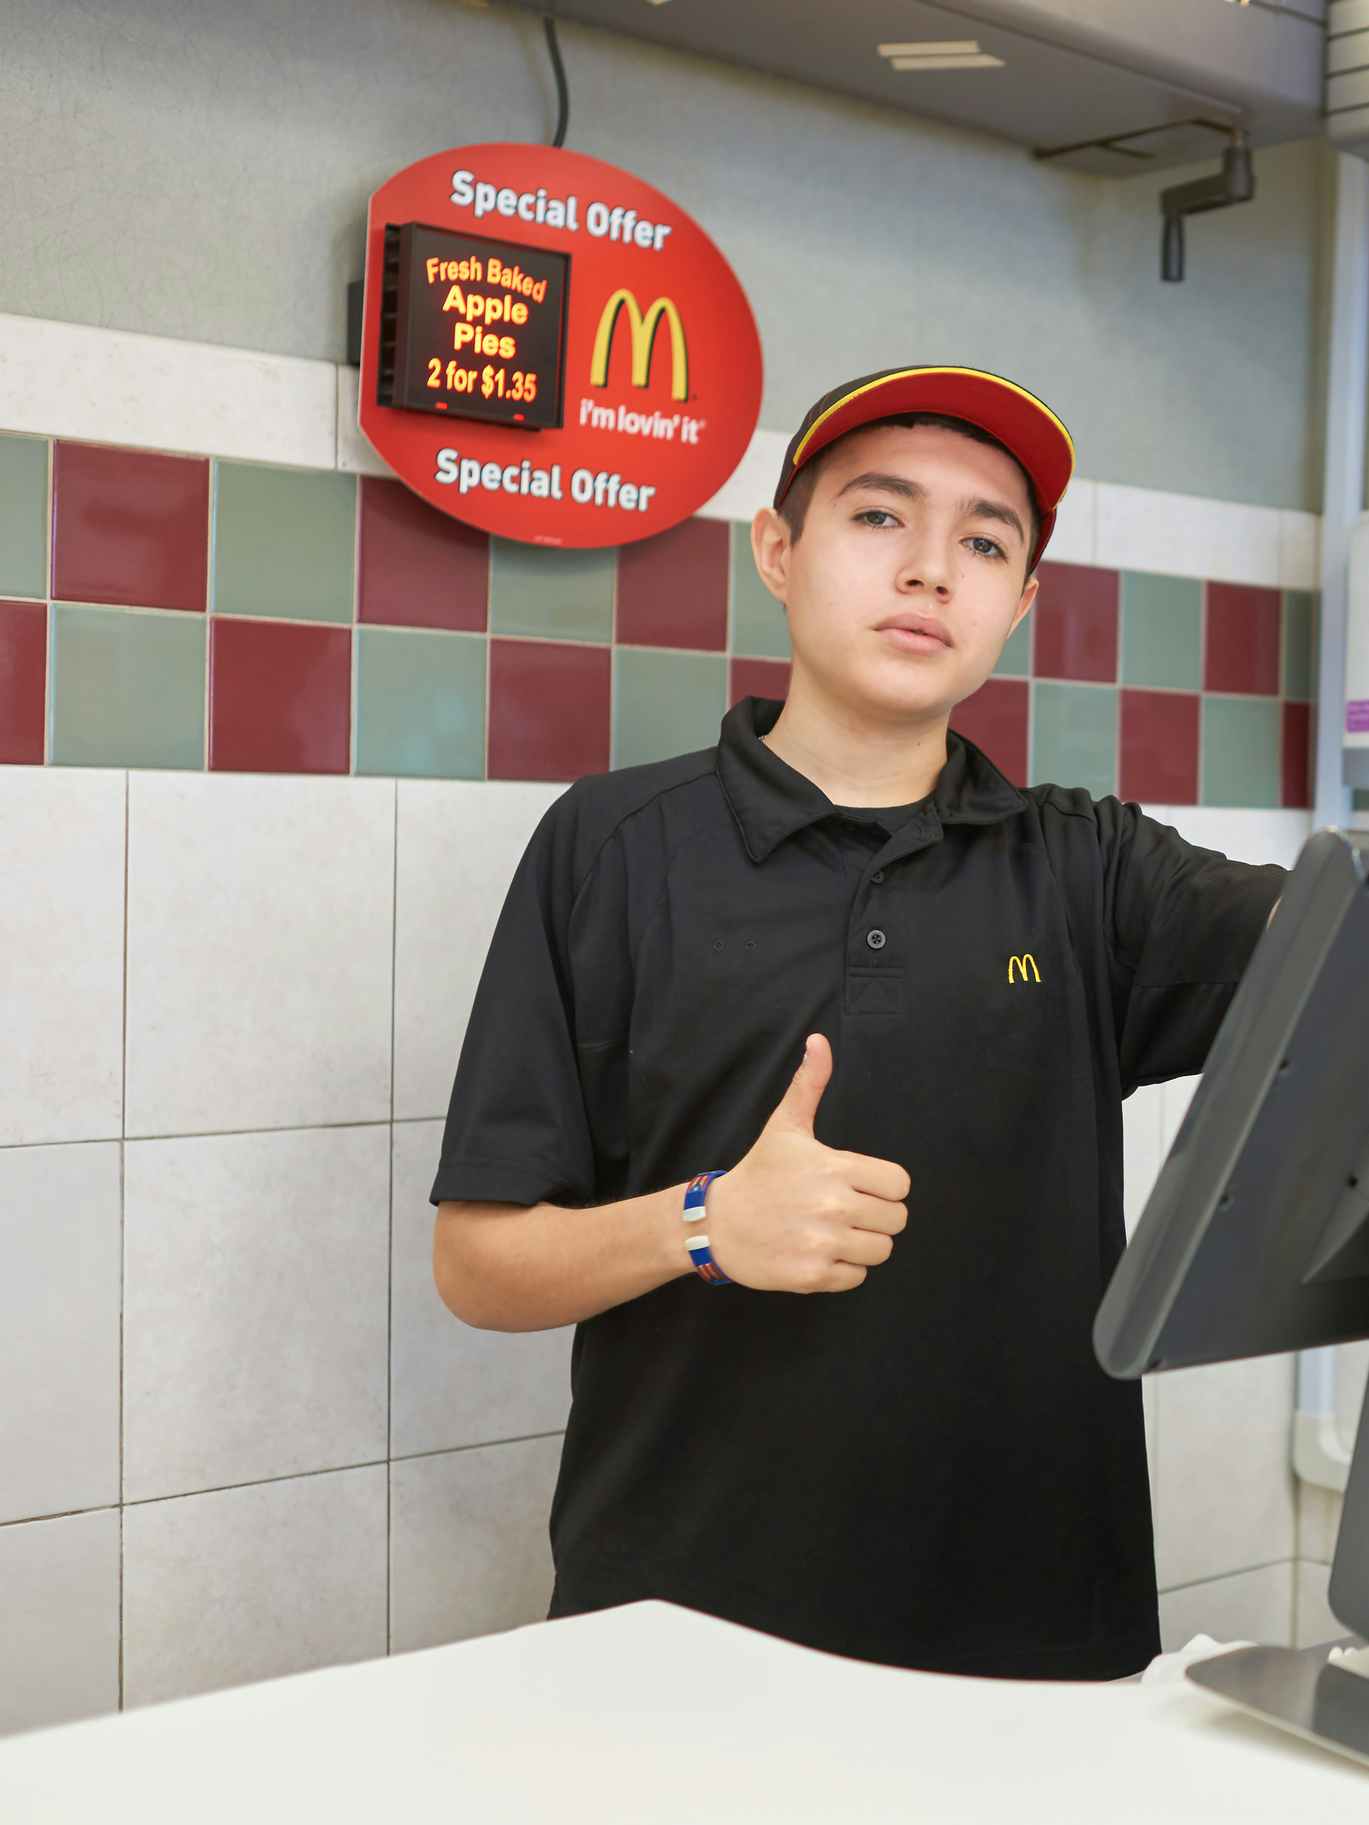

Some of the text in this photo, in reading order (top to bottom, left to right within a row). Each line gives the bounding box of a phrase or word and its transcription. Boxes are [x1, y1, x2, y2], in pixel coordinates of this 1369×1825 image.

[450, 168, 672, 251] Special Offer
[426, 255, 548, 304] Fresh Baked
[442, 284, 529, 326] Apple
[453, 321, 516, 360] Pies
[426, 357, 537, 403] 2 for $1.35
[579, 398, 616, 432] I'm
[617, 404, 680, 441] lovin'
[434, 446, 657, 513] Special Offer
